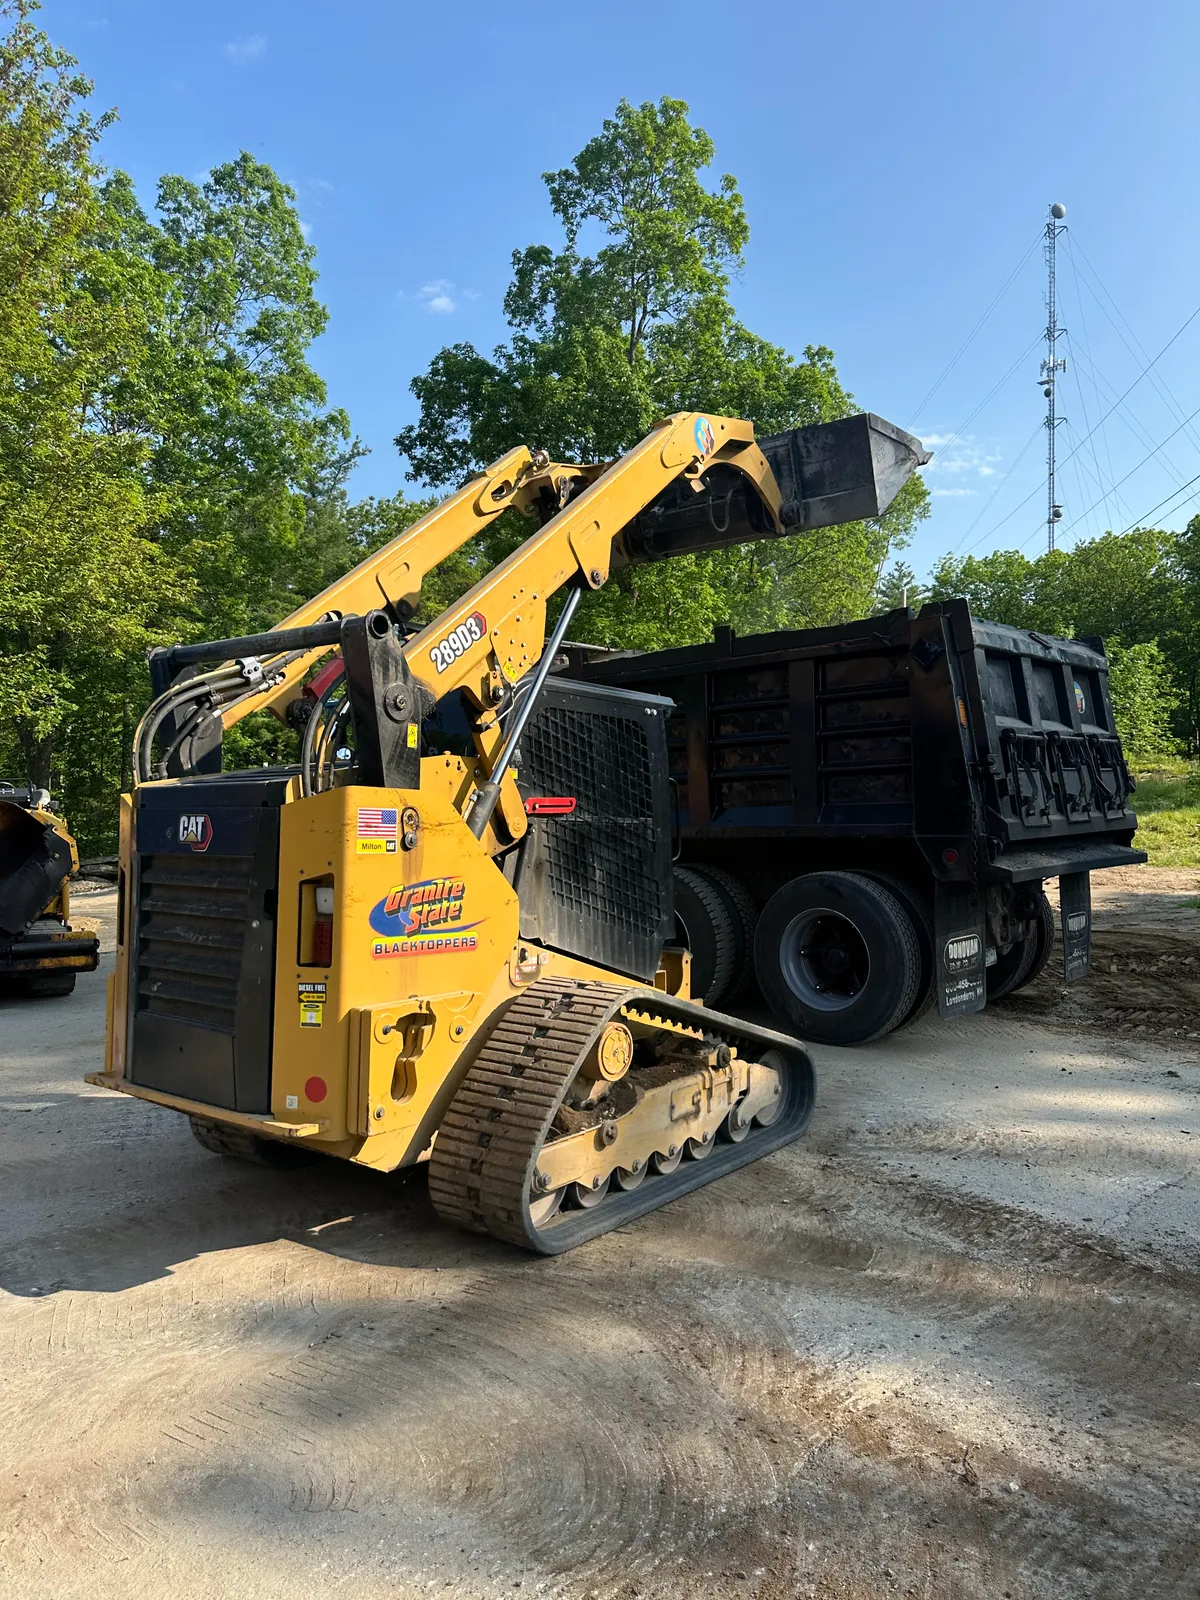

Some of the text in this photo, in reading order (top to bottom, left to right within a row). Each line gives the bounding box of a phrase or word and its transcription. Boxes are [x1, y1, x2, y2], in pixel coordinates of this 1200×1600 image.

[430, 617, 481, 674] 289D3
[180, 815, 205, 842] CAT
[384, 879, 466, 917] Granite
[404, 898, 463, 938] State
[374, 936, 477, 955] BLACKTOPPERS
[948, 938, 979, 959] DONOVAN
[298, 984, 326, 992] DIESEL FUEL
